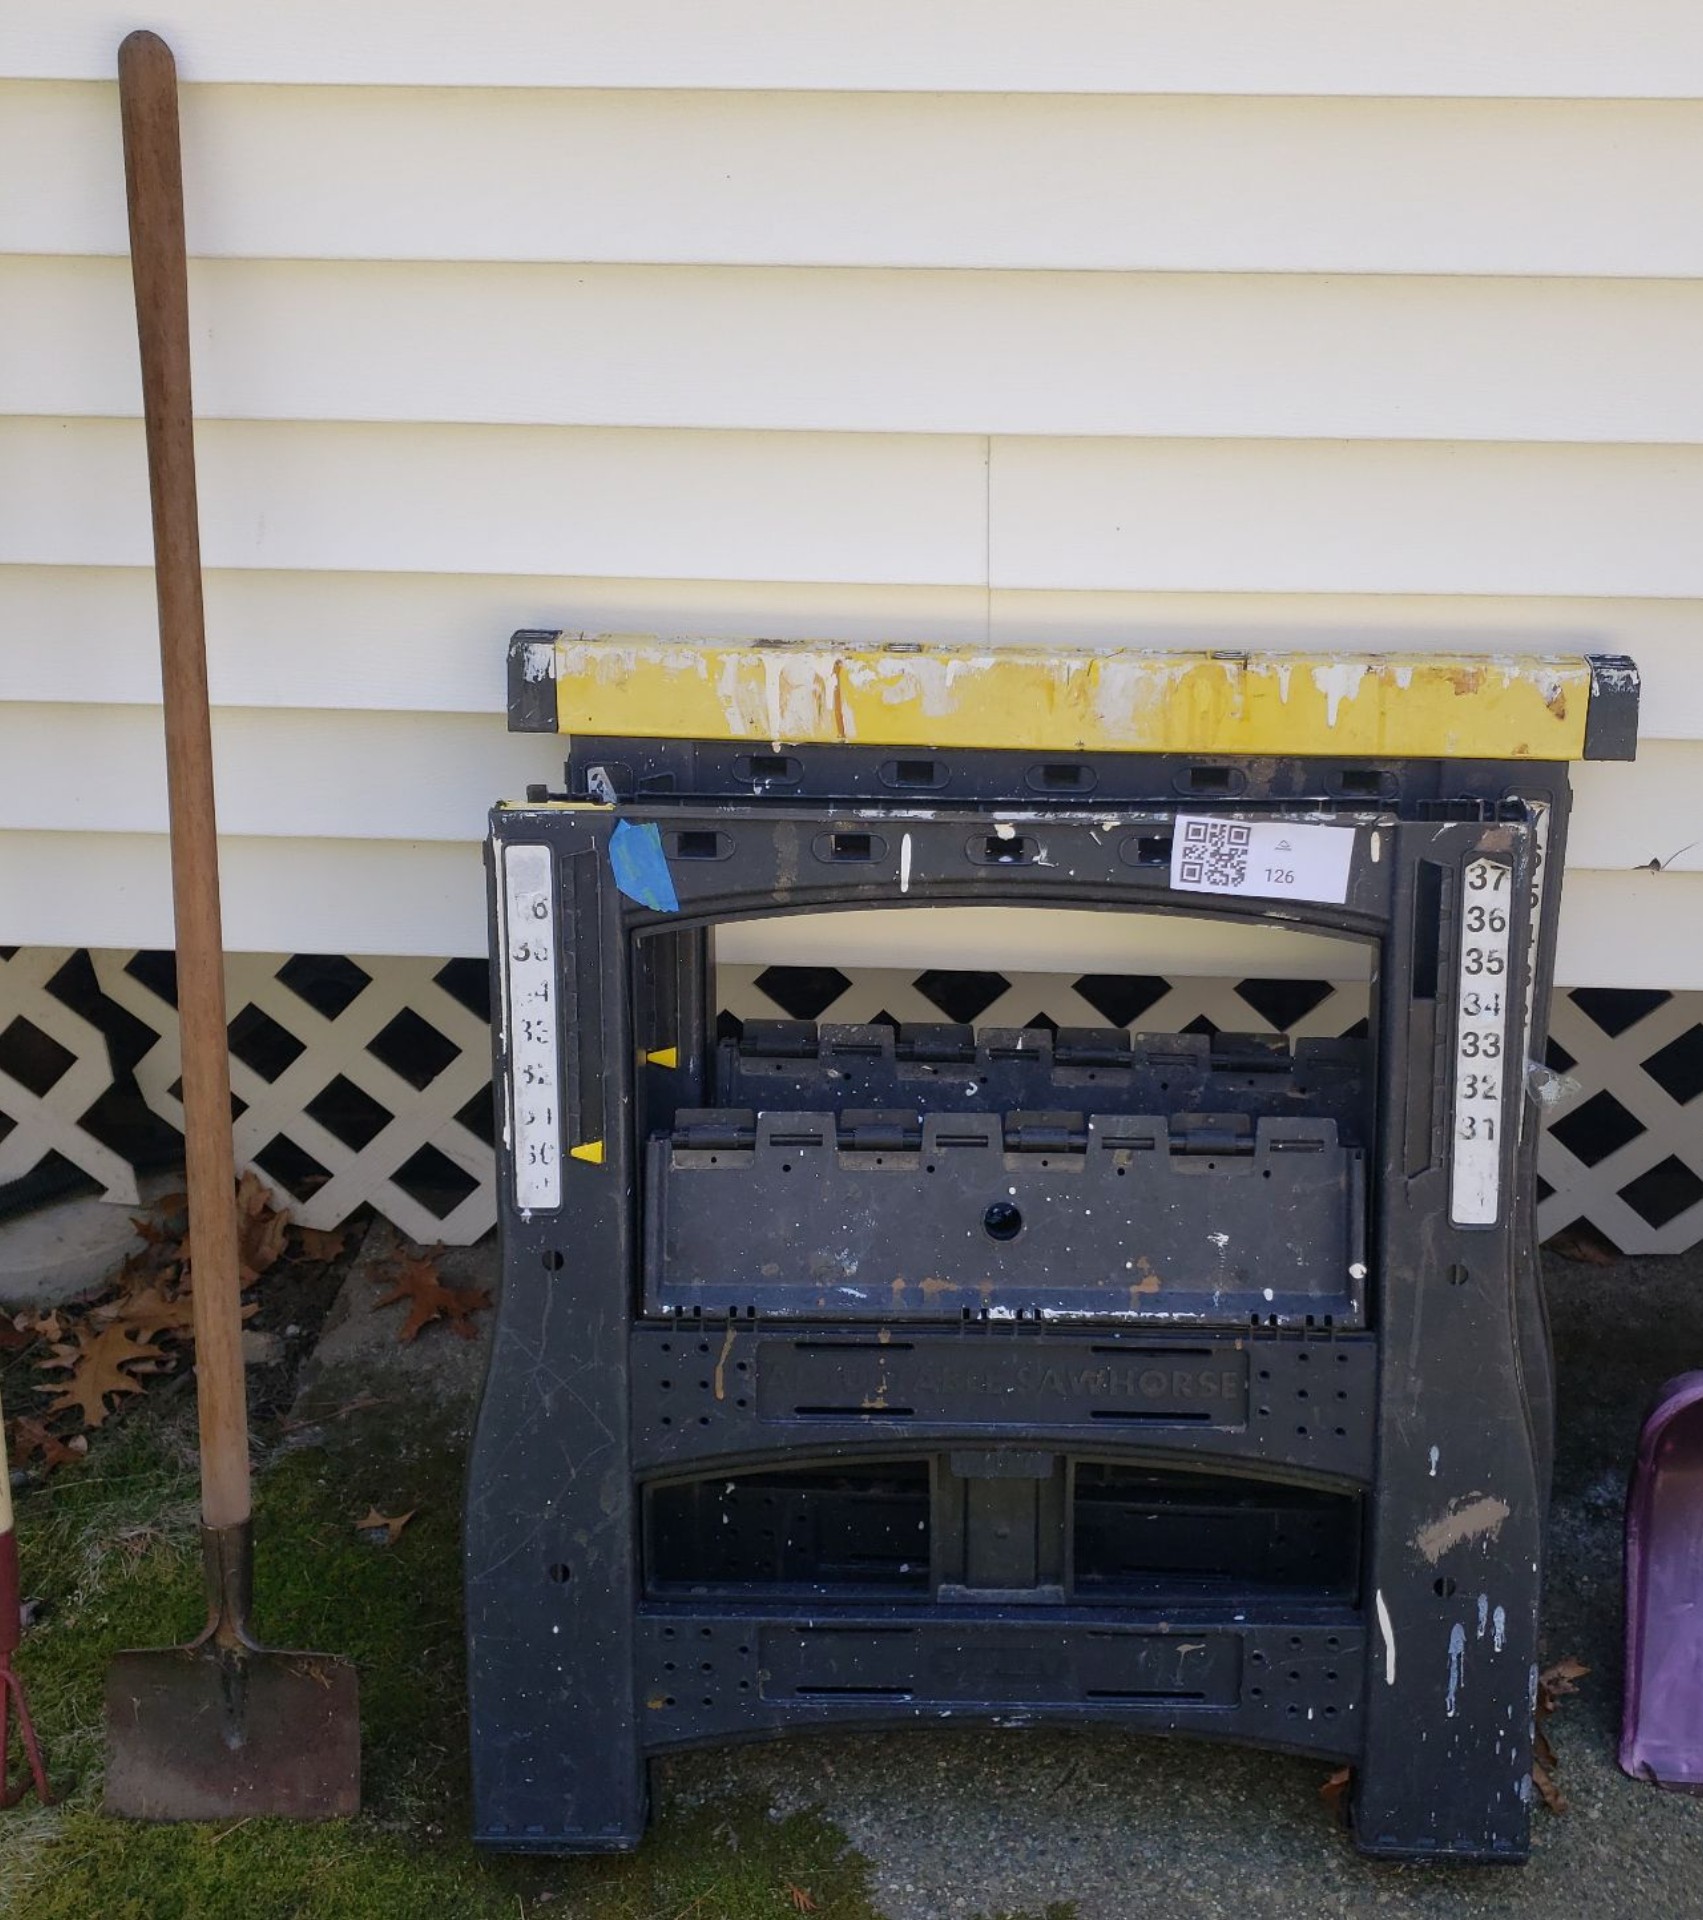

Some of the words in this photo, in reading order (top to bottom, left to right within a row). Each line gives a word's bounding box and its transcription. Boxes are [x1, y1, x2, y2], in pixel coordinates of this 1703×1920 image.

[1265, 868, 1295, 884] 126
[1468, 864, 1510, 891] 37
[1466, 905, 1506, 933] 36
[1464, 947, 1505, 975] 35
[1463, 992, 1500, 1016] 34
[1461, 1031, 1501, 1058] 33
[1462, 1073, 1498, 1100] 32
[1459, 1116, 1494, 1141] 31
[1016, 1366, 1238, 1399] SAWHORSE
